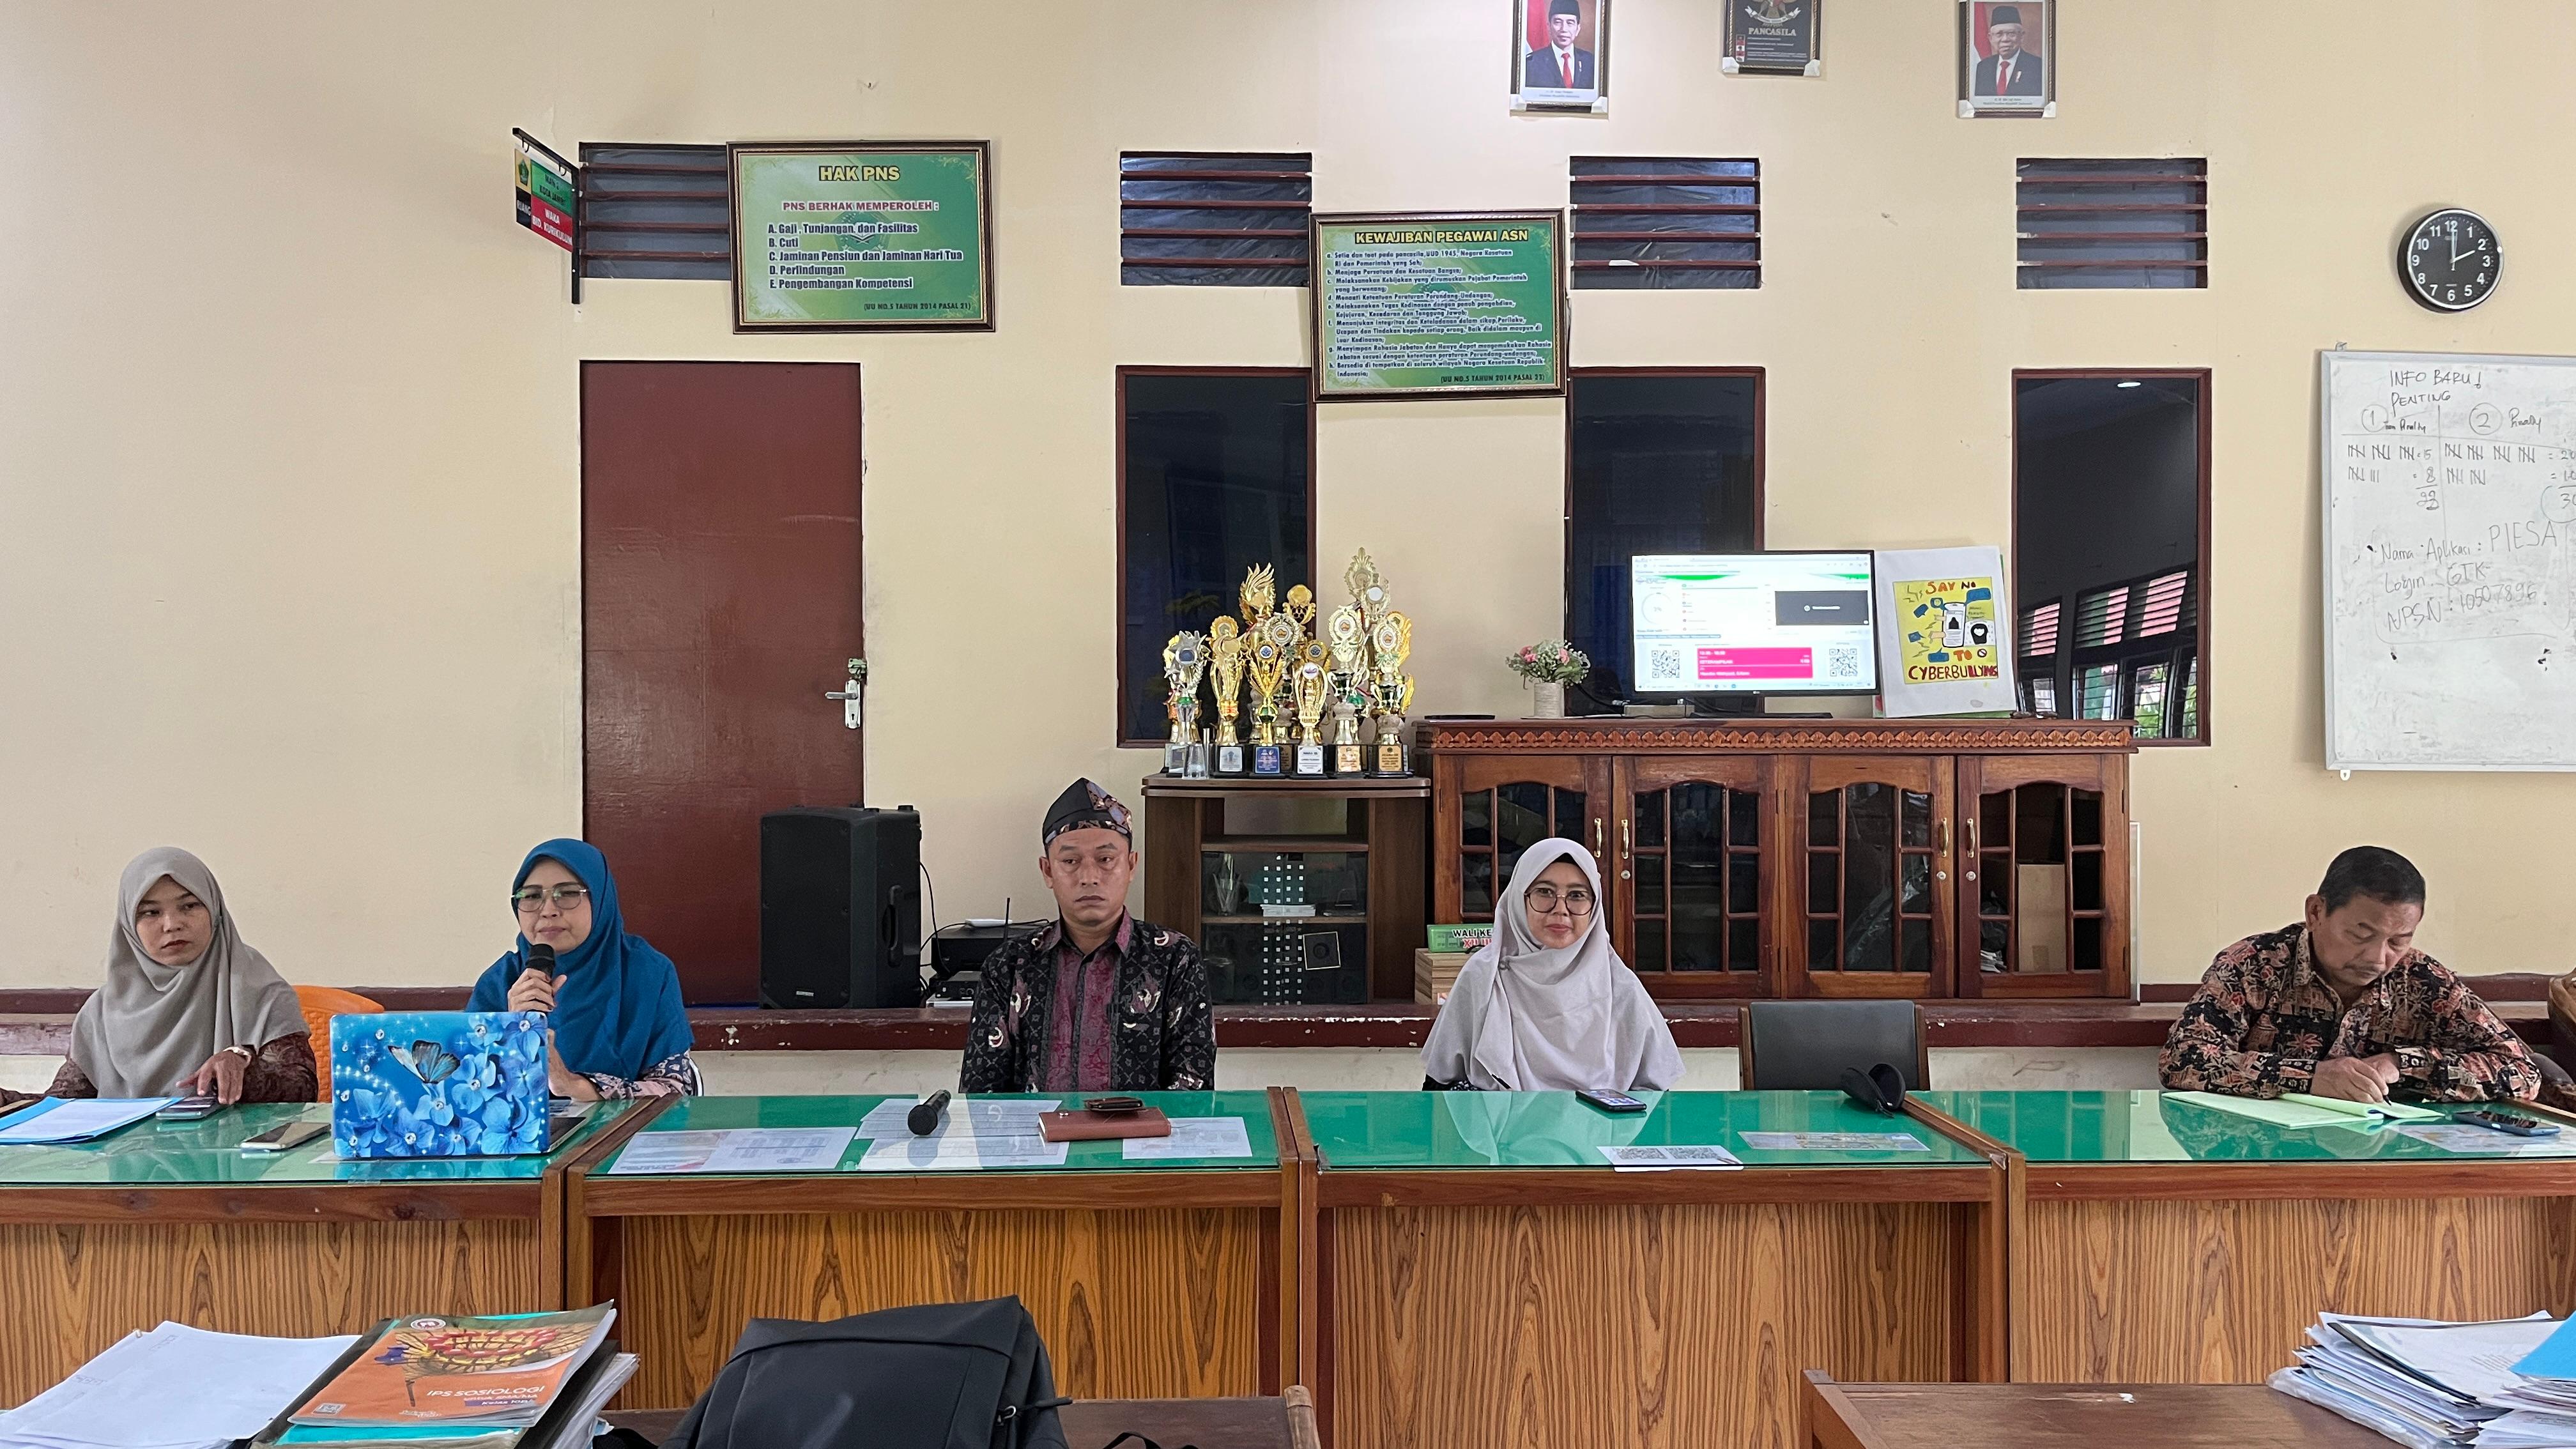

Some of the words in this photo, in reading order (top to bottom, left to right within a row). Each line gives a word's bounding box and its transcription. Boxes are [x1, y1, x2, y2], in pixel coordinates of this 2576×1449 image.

[1749, 27, 1796, 36] PANCASILA
[819, 165, 859, 181] HAK
[862, 165, 900, 181] PNS
[783, 202, 805, 211] PNS
[809, 202, 853, 211] BERHAK
[769, 224, 778, 234] A.
[858, 224, 875, 233] dan
[878, 224, 918, 233] Fasilitas
[2430, 225, 2441, 237] 11
[2444, 220, 2457, 232] 12
[2467, 226, 2472, 238] 1
[769, 238, 778, 247] B.
[779, 238, 799, 247] Cuti
[1355, 231, 1432, 244] KEWAJIBAN
[1436, 230, 1497, 243] PEGAWAI
[1500, 229, 1528, 241] ASN
[2417, 238, 2429, 250] 10
[2478, 238, 2486, 250] 2
[769, 252, 778, 261] C.
[779, 252, 819, 261] Jaminan
[822, 251, 860, 261] Pensiun
[862, 251, 880, 261] dan
[882, 251, 921, 261] Jaminan
[924, 251, 943, 260] Hari
[945, 251, 962, 260] Tua
[2412, 255, 2419, 266] 9
[2482, 255, 2490, 267] 3
[770, 266, 778, 275] D.
[781, 265, 845, 276] Perlindungan
[770, 279, 777, 288] E.
[779, 279, 853, 289] Pengembangan
[856, 279, 912, 289] Kompetensi
[2418, 273, 2425, 284] 8
[2476, 273, 2485, 284] 4
[2430, 284, 2438, 296] 7
[2447, 289, 2455, 301] 6
[2464, 284, 2472, 296] 5
[2390, 370, 2426, 388] INFO
[2391, 390, 2451, 417] PENTING
[1926, 581, 1955, 595] SAY
[2387, 597, 2442, 632] NPSN
[1954, 650, 1972, 661] TO
[454, 1386, 545, 1396] SOSIOLOGI
